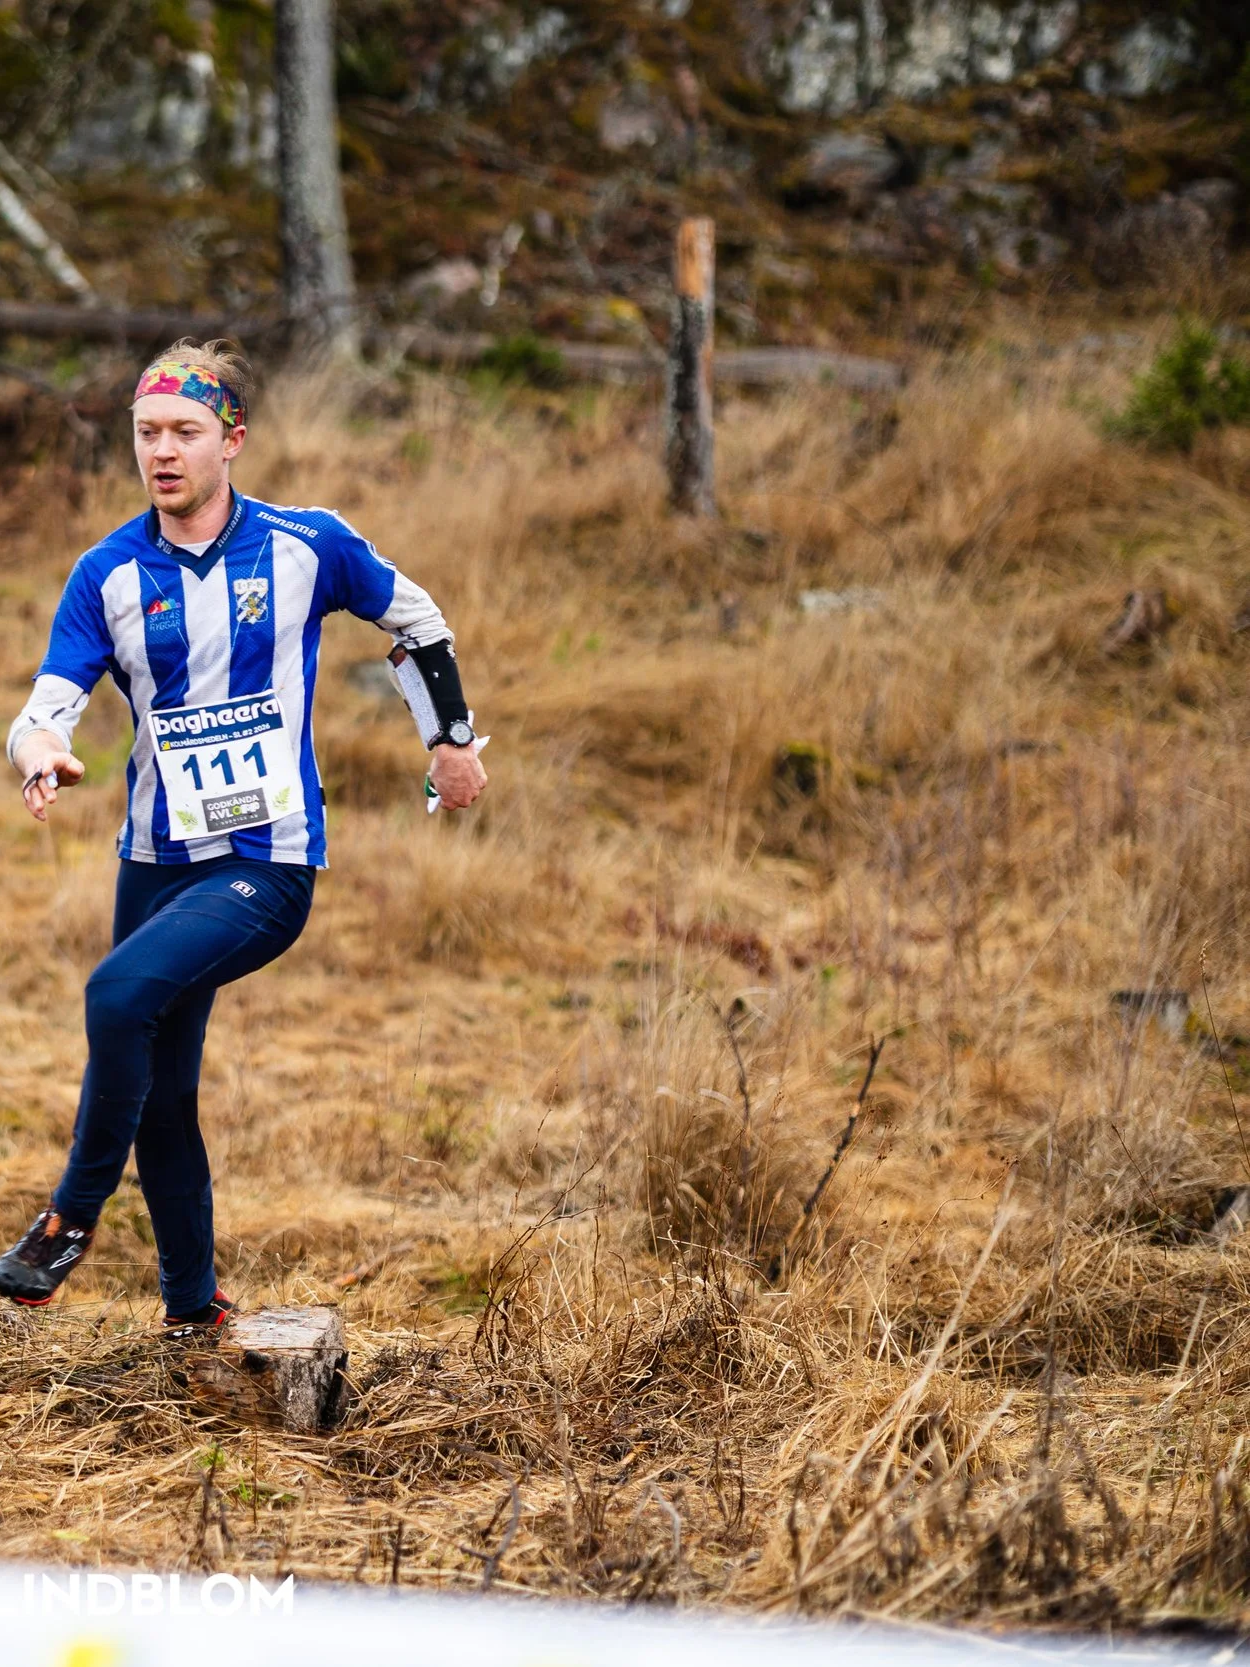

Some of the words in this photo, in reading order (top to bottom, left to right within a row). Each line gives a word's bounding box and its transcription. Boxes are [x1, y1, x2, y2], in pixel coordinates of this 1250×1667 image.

[216, 503, 243, 548] noname
[257, 511, 319, 539] noname
[152, 698, 280, 736] bagheera
[182, 741, 267, 791] 111
[208, 801, 260, 822] AVLOPP
